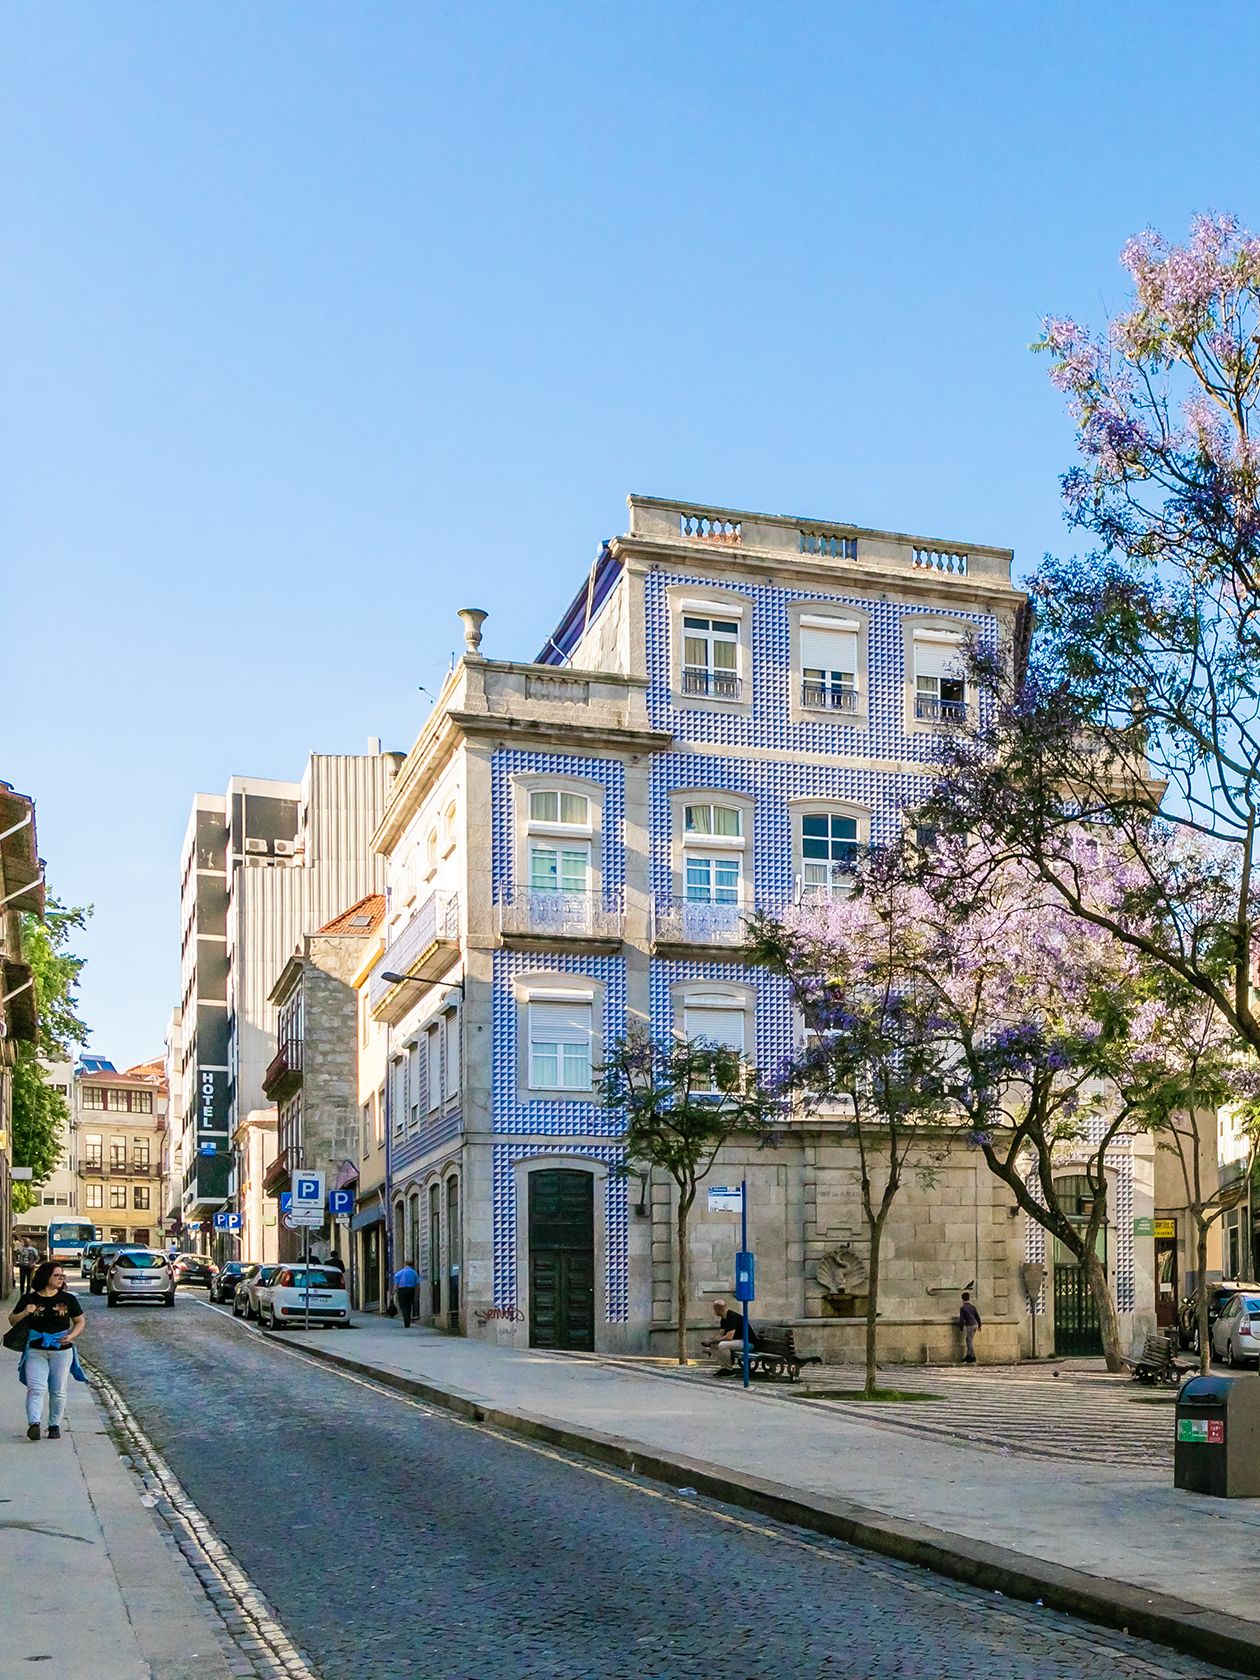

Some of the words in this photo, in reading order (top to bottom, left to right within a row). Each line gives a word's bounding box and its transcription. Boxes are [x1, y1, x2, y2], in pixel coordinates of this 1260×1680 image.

[202, 1072, 214, 1128] HOTEL
[302, 1182, 314, 1198] P
[335, 1192, 348, 1211] P
[217, 1214, 225, 1225] P
[228, 1215, 238, 1228] P
